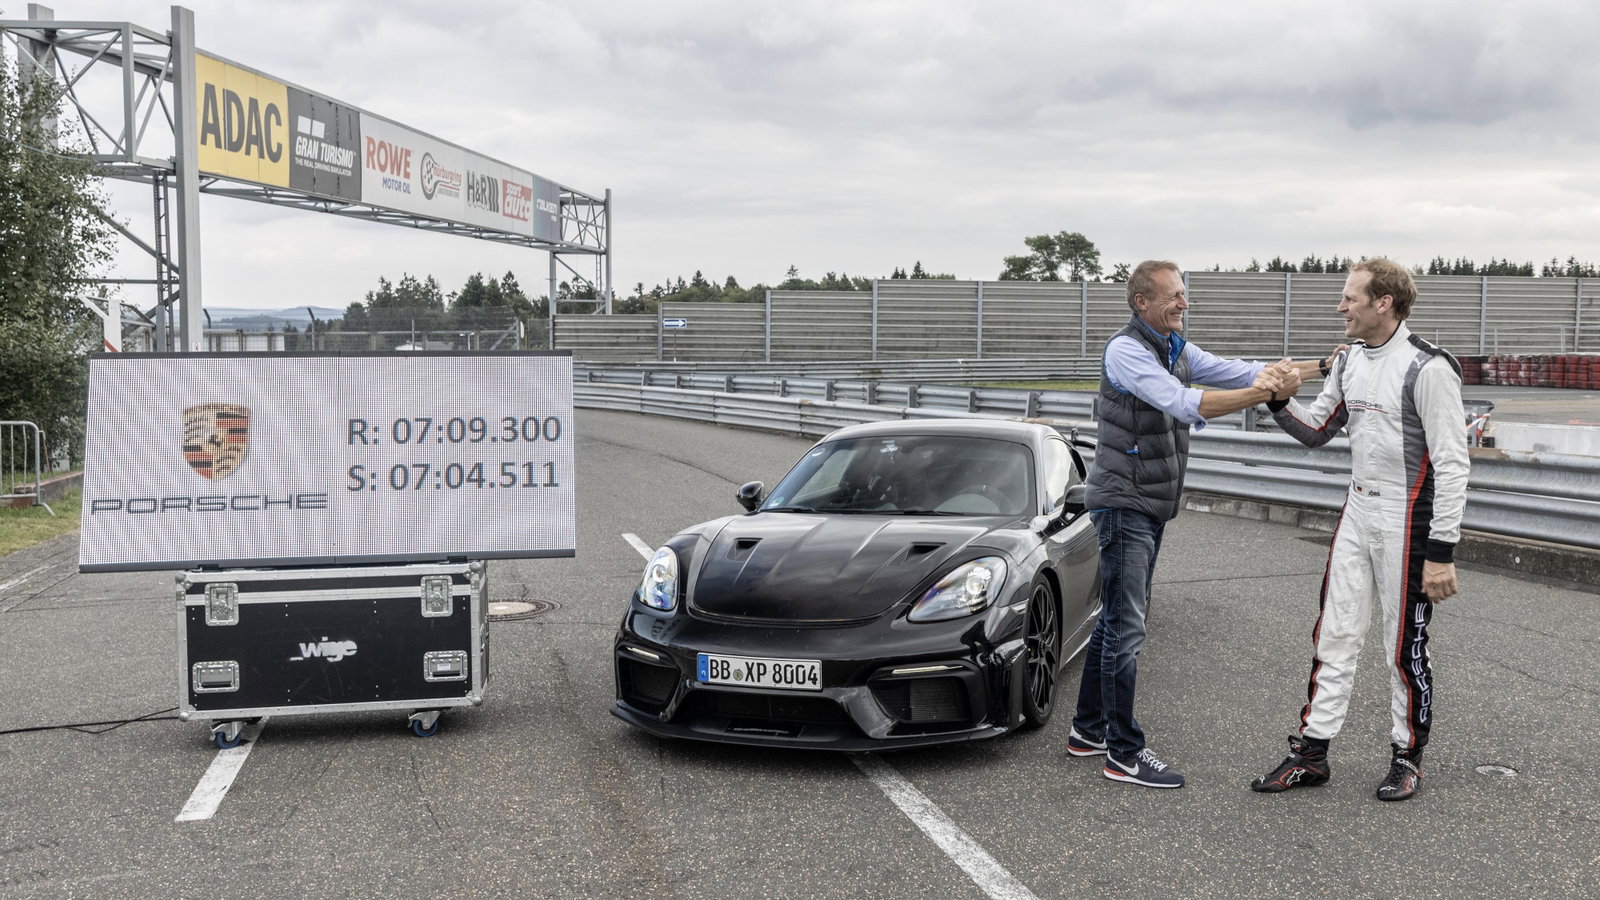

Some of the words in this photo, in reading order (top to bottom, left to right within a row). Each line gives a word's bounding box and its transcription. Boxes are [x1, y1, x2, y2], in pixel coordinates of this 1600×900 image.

[201, 82, 283, 163] ADAC
[295, 135, 319, 160] GRAN
[320, 142, 354, 169] TURISMO
[295, 156, 304, 166] THE
[303, 159, 315, 169] REAL
[365, 135, 411, 180] ROWE
[382, 177, 402, 193] MOTOR
[402, 182, 411, 195] OIL
[467, 170, 488, 206] H&R
[504, 196, 531, 219] auto
[347, 418, 379, 445] R:
[392, 416, 561, 444] 07:09.300
[347, 464, 377, 492] S:
[389, 461, 559, 491] 07:04.511
[91, 493, 328, 515] PORSCHE
[709, 659, 731, 680] BB
[745, 661, 767, 682] XP
[772, 663, 818, 686] 8004
[1411, 602, 1431, 724] PORSCHE
